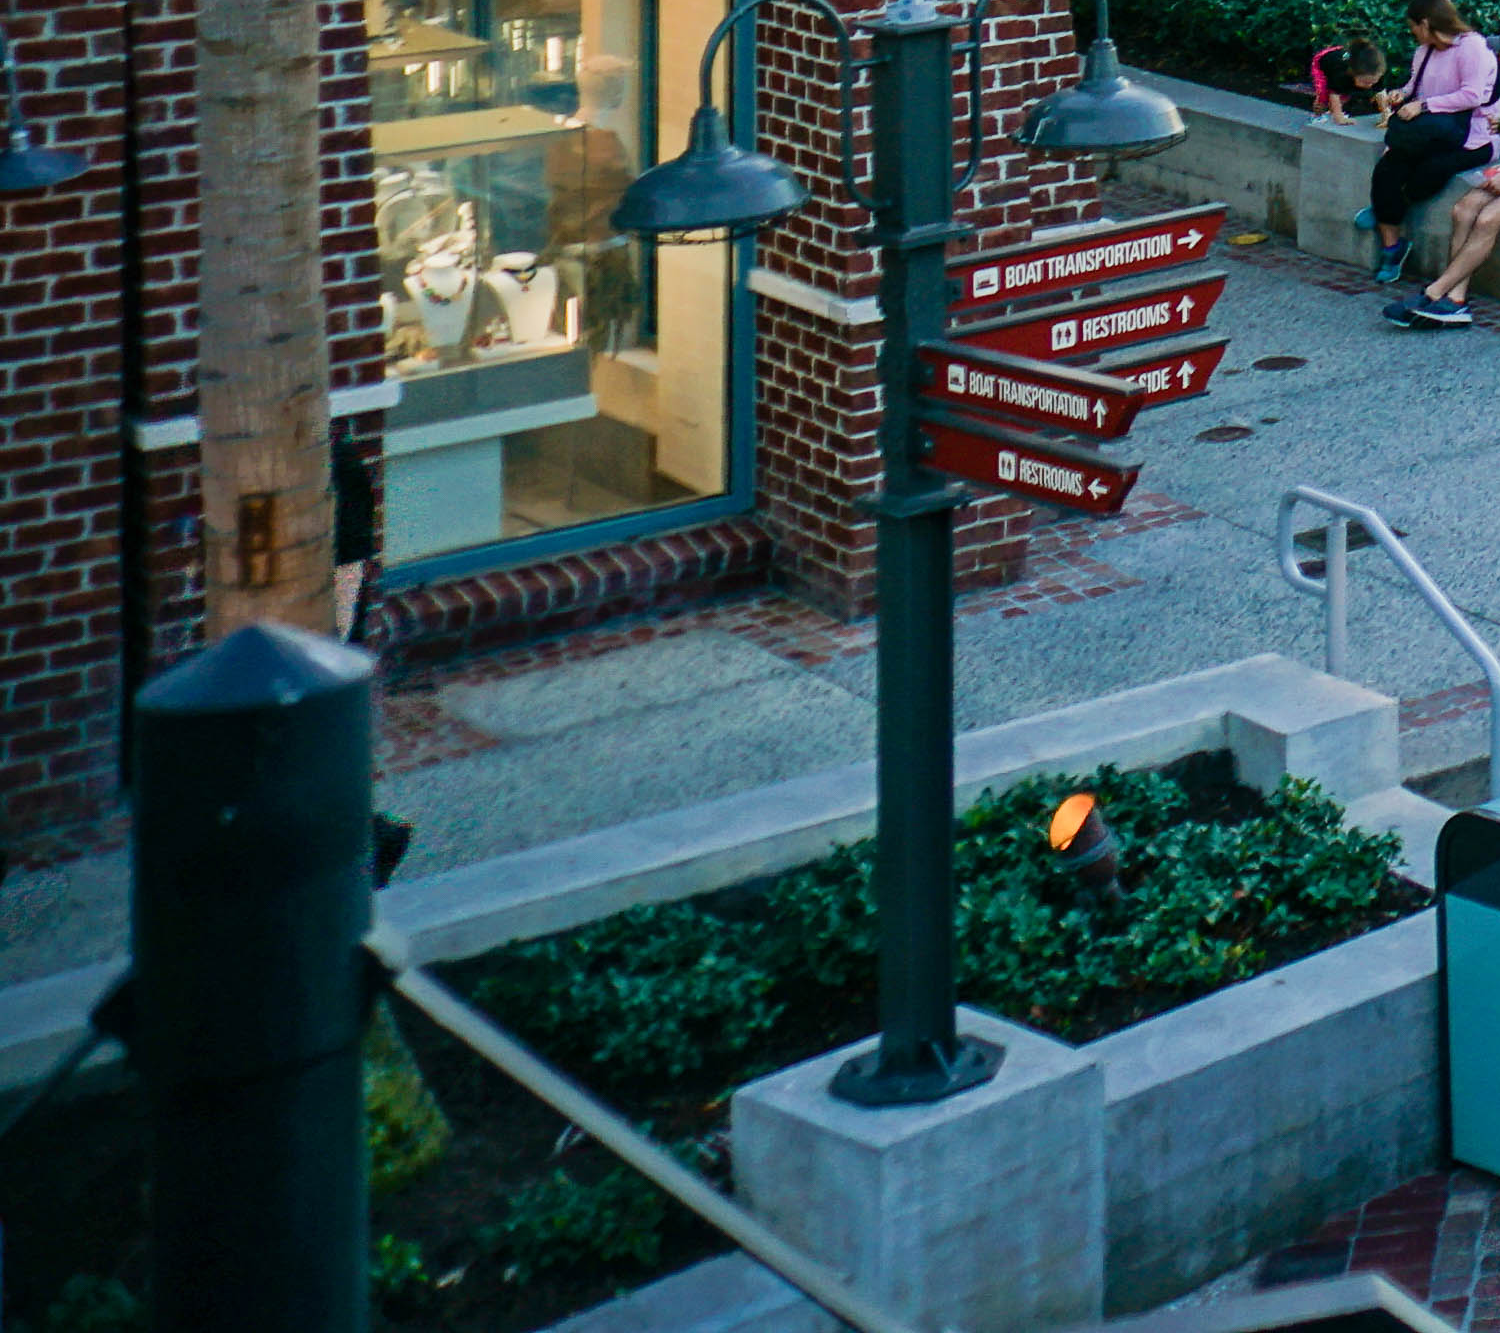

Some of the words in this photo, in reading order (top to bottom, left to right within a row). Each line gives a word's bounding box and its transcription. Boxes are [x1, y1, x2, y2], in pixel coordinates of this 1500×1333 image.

[1005, 259, 1044, 289] BOAT
[1047, 233, 1173, 280] TRANSPORTATION
[1082, 301, 1170, 342] RESTROOMS
[968, 371, 997, 398] BOAT
[998, 378, 1089, 422] TRANSPORTATION
[1138, 366, 1172, 394] SIDE
[1019, 457, 1084, 497] RESTROOMS
